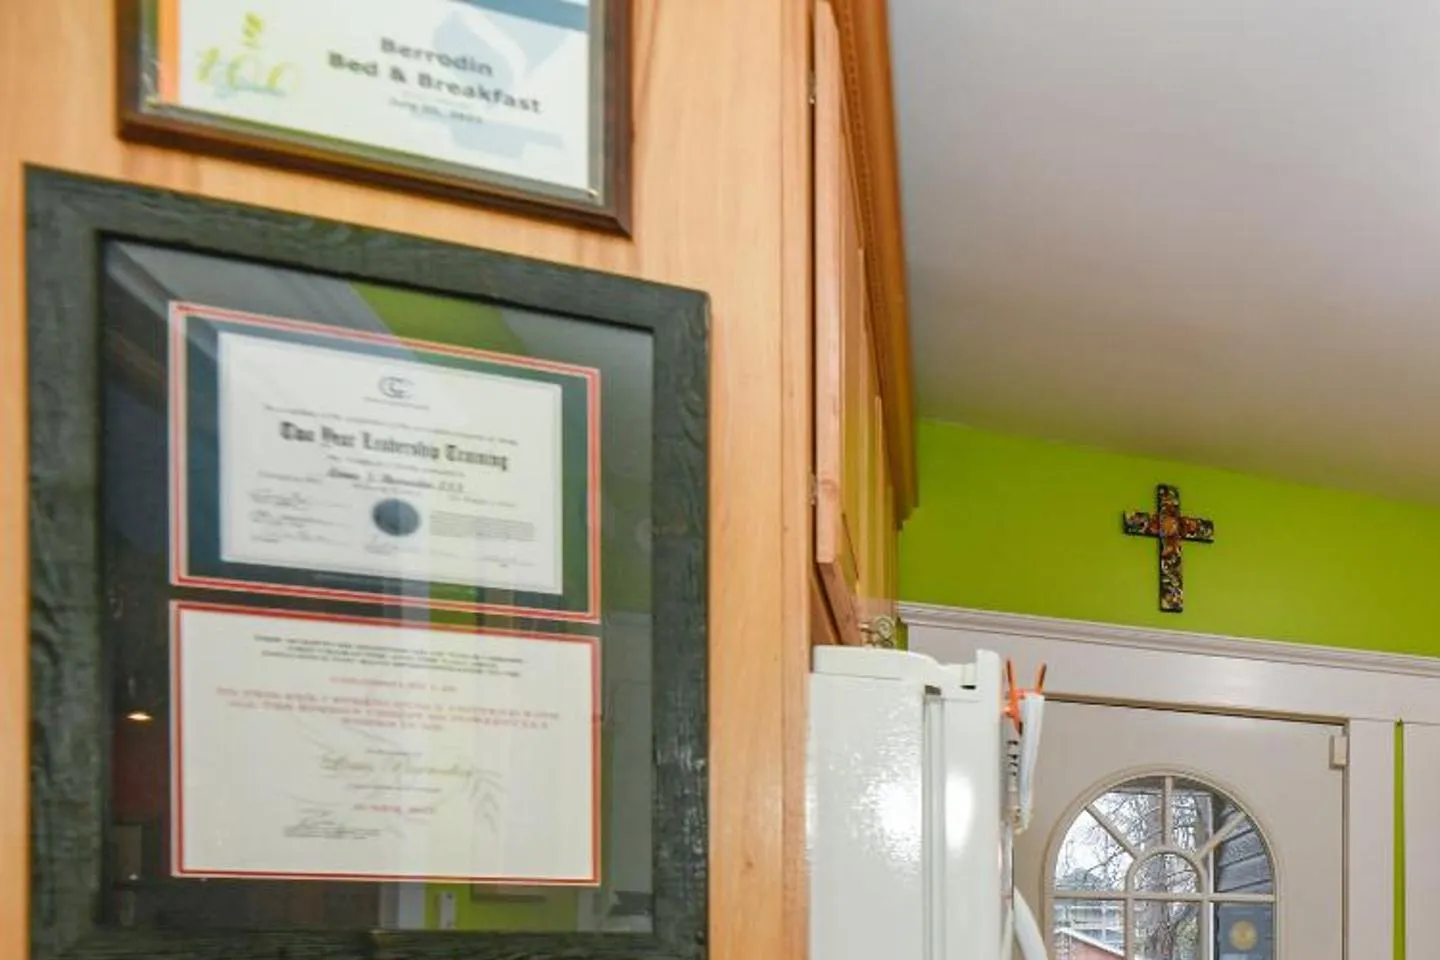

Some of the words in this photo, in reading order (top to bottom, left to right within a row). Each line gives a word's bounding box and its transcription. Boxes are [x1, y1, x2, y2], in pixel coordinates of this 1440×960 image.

[328, 50, 379, 78] Bed
[390, 66, 407, 84] &
[418, 72, 542, 114] Breakfast
[380, 36, 494, 78] Berrodin
